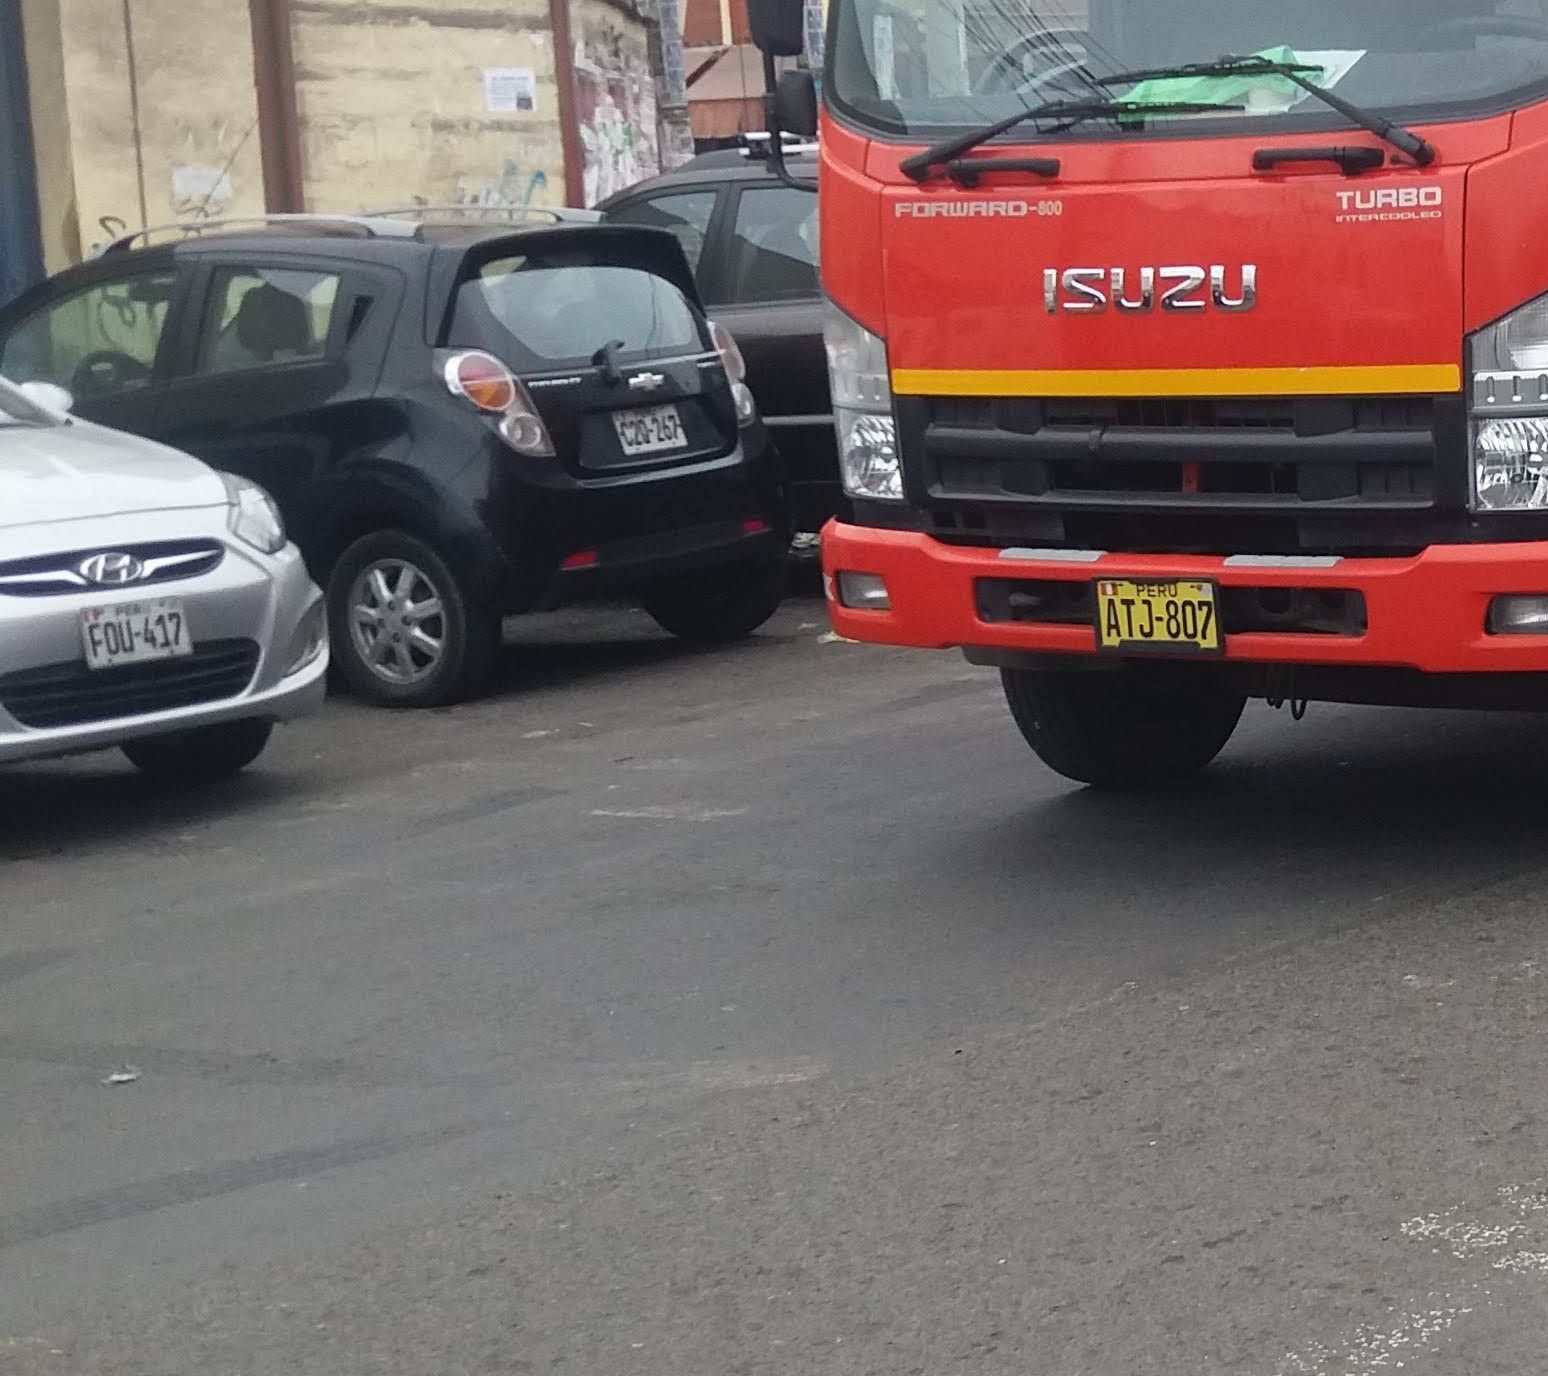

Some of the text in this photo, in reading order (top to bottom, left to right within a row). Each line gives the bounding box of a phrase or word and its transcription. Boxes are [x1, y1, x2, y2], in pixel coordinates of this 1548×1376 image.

[1335, 186, 1442, 210] TURBO
[1043, 264, 1258, 314] ISUZU
[1136, 583, 1178, 598] PERU
[1107, 598, 1213, 640] ATJ-807
